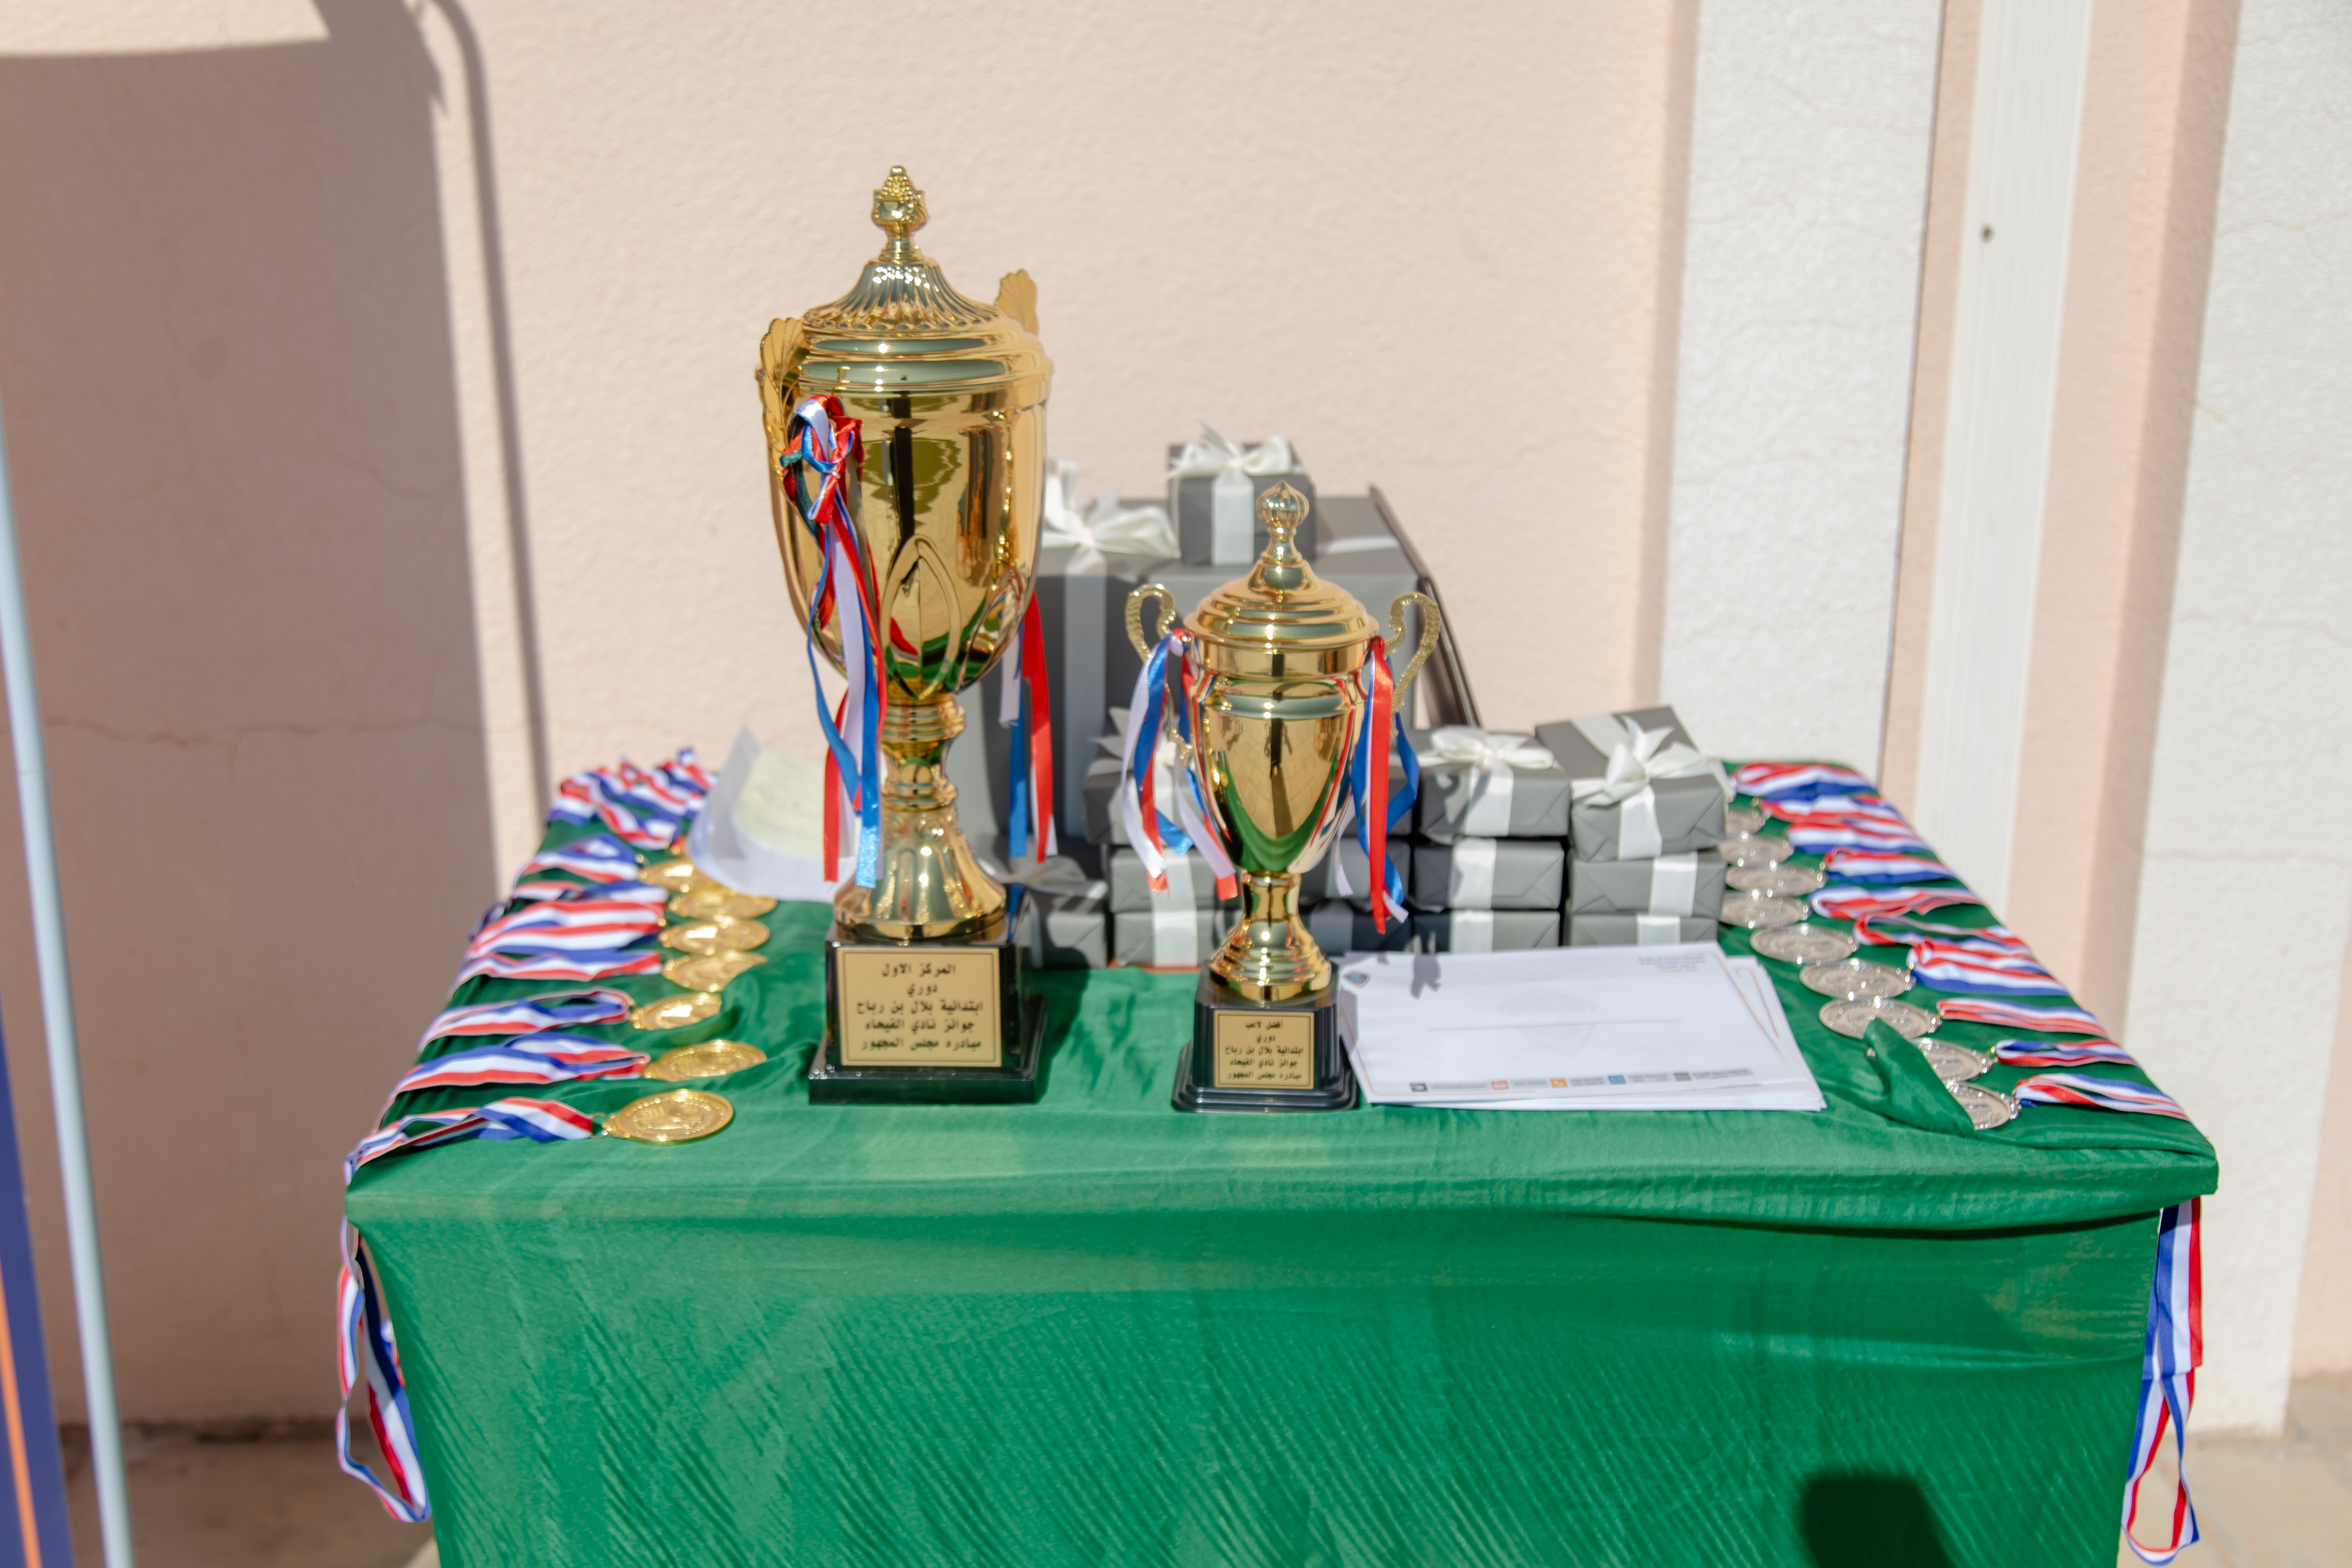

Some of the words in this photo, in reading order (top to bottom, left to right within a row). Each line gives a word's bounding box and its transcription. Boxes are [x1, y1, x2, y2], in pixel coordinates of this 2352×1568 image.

[918, 962, 955, 978] المركز
[907, 983, 938, 998] دوري
[856, 1001, 885, 1015] رباح
[891, 1001, 904, 1015] بن
[910, 1001, 933, 1015] بلال
[865, 1019, 905, 1033] الفيحاء
[910, 1019, 937, 1034] نادي
[1245, 1020, 1262, 1030] لاعب
[910, 1039, 940, 1052] مجلس
[1256, 1035, 1276, 1044] دوري
[1225, 1045, 1242, 1055] رباح
[1246, 1046, 1255, 1056] بن
[1258, 1046, 1272, 1056] بلال
[1258, 1058, 1274, 1069] نادي
